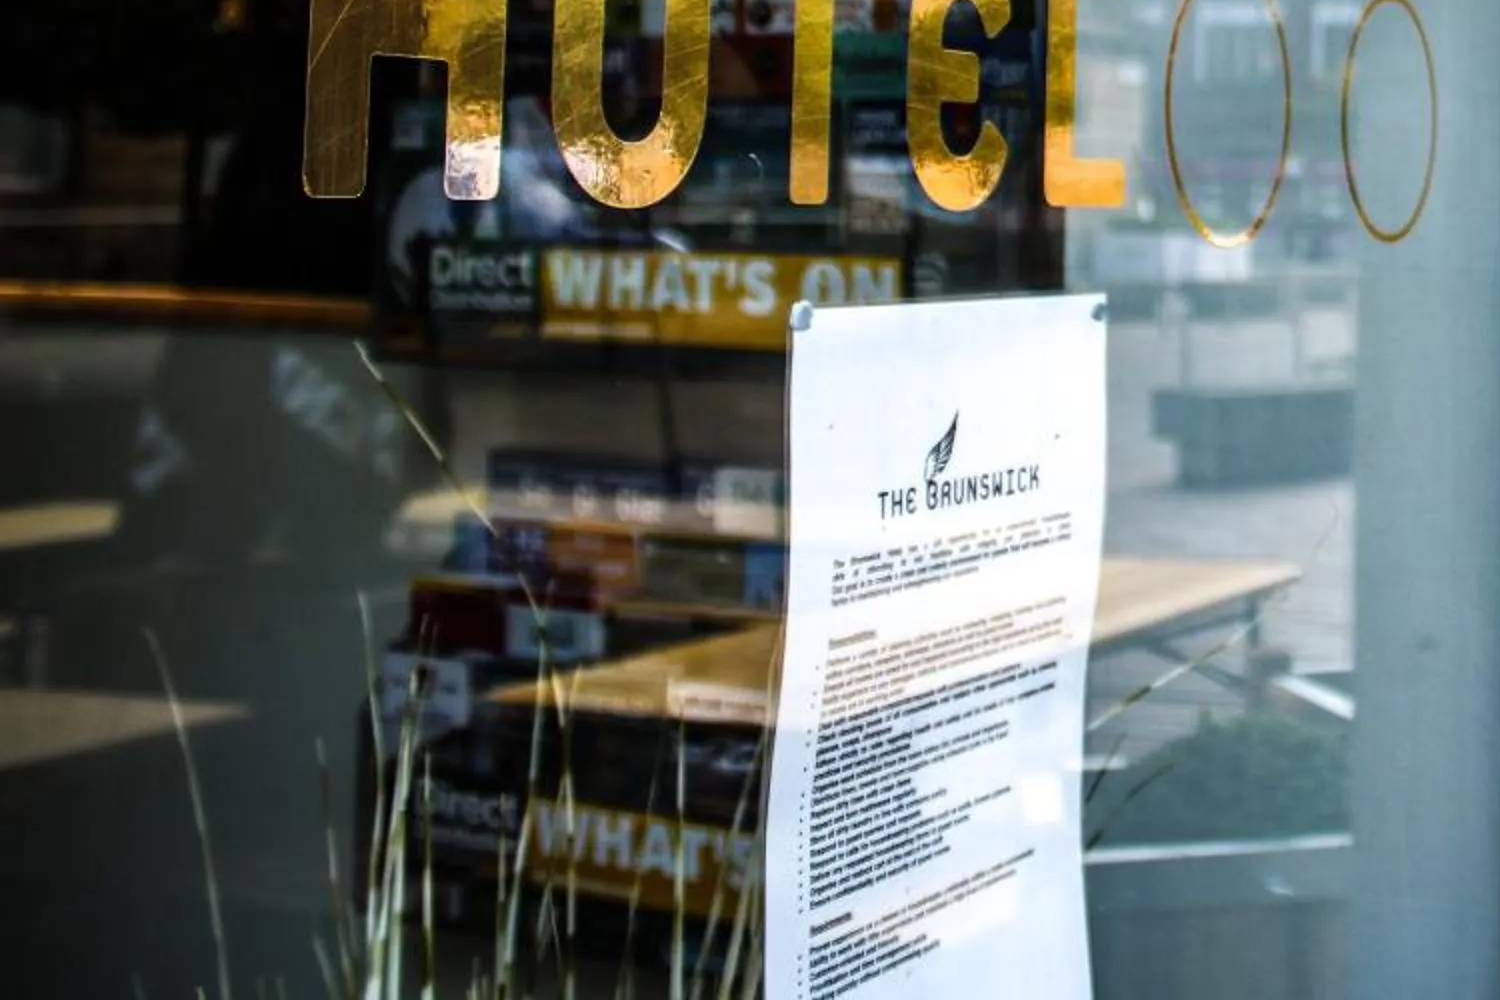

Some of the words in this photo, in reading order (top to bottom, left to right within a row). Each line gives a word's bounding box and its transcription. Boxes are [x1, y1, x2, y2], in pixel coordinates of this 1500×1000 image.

[431, 247, 533, 288] Direct
[549, 252, 778, 318] WHAT'S
[799, 260, 897, 304] ON
[877, 487, 917, 520] THE
[926, 464, 1041, 511] BRUNSWICK
